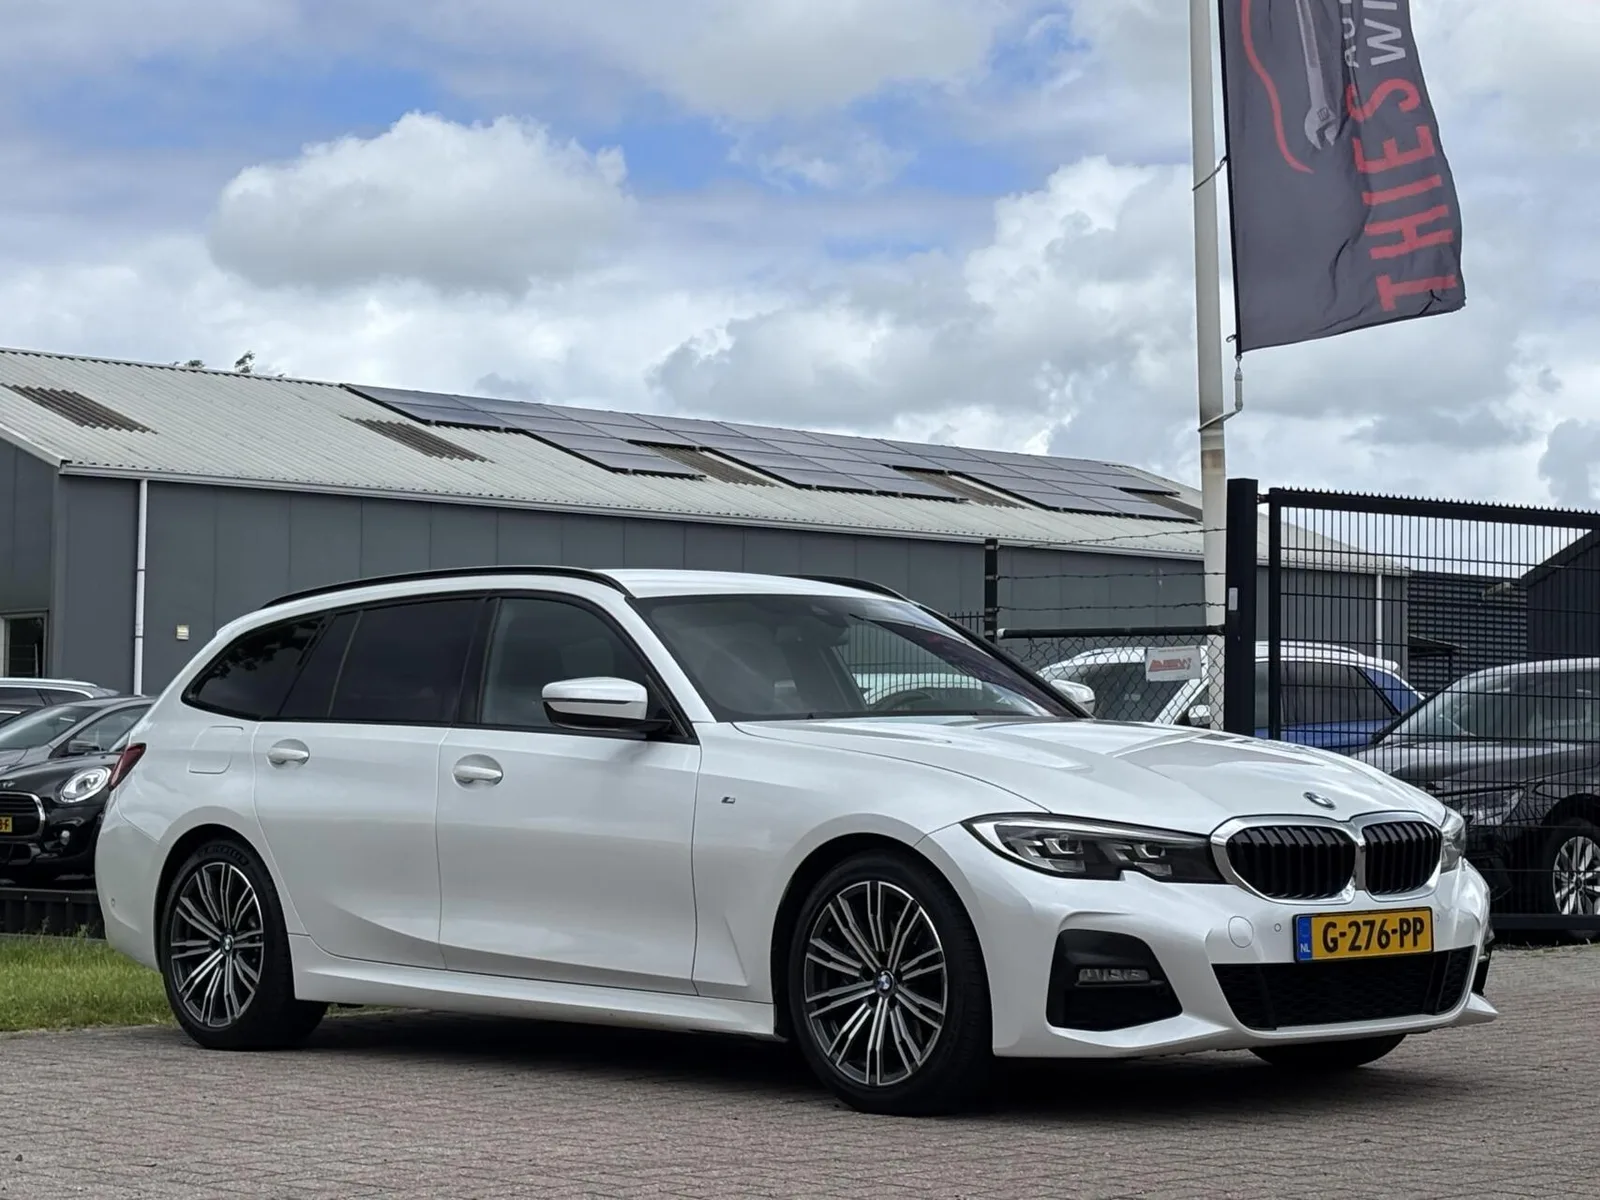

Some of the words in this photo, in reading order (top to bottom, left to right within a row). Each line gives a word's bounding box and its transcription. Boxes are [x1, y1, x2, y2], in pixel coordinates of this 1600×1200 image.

[1346, 78, 1458, 312] THIES
[1300, 943, 1311, 953] NL
[1322, 916, 1425, 953] G-276-PP
